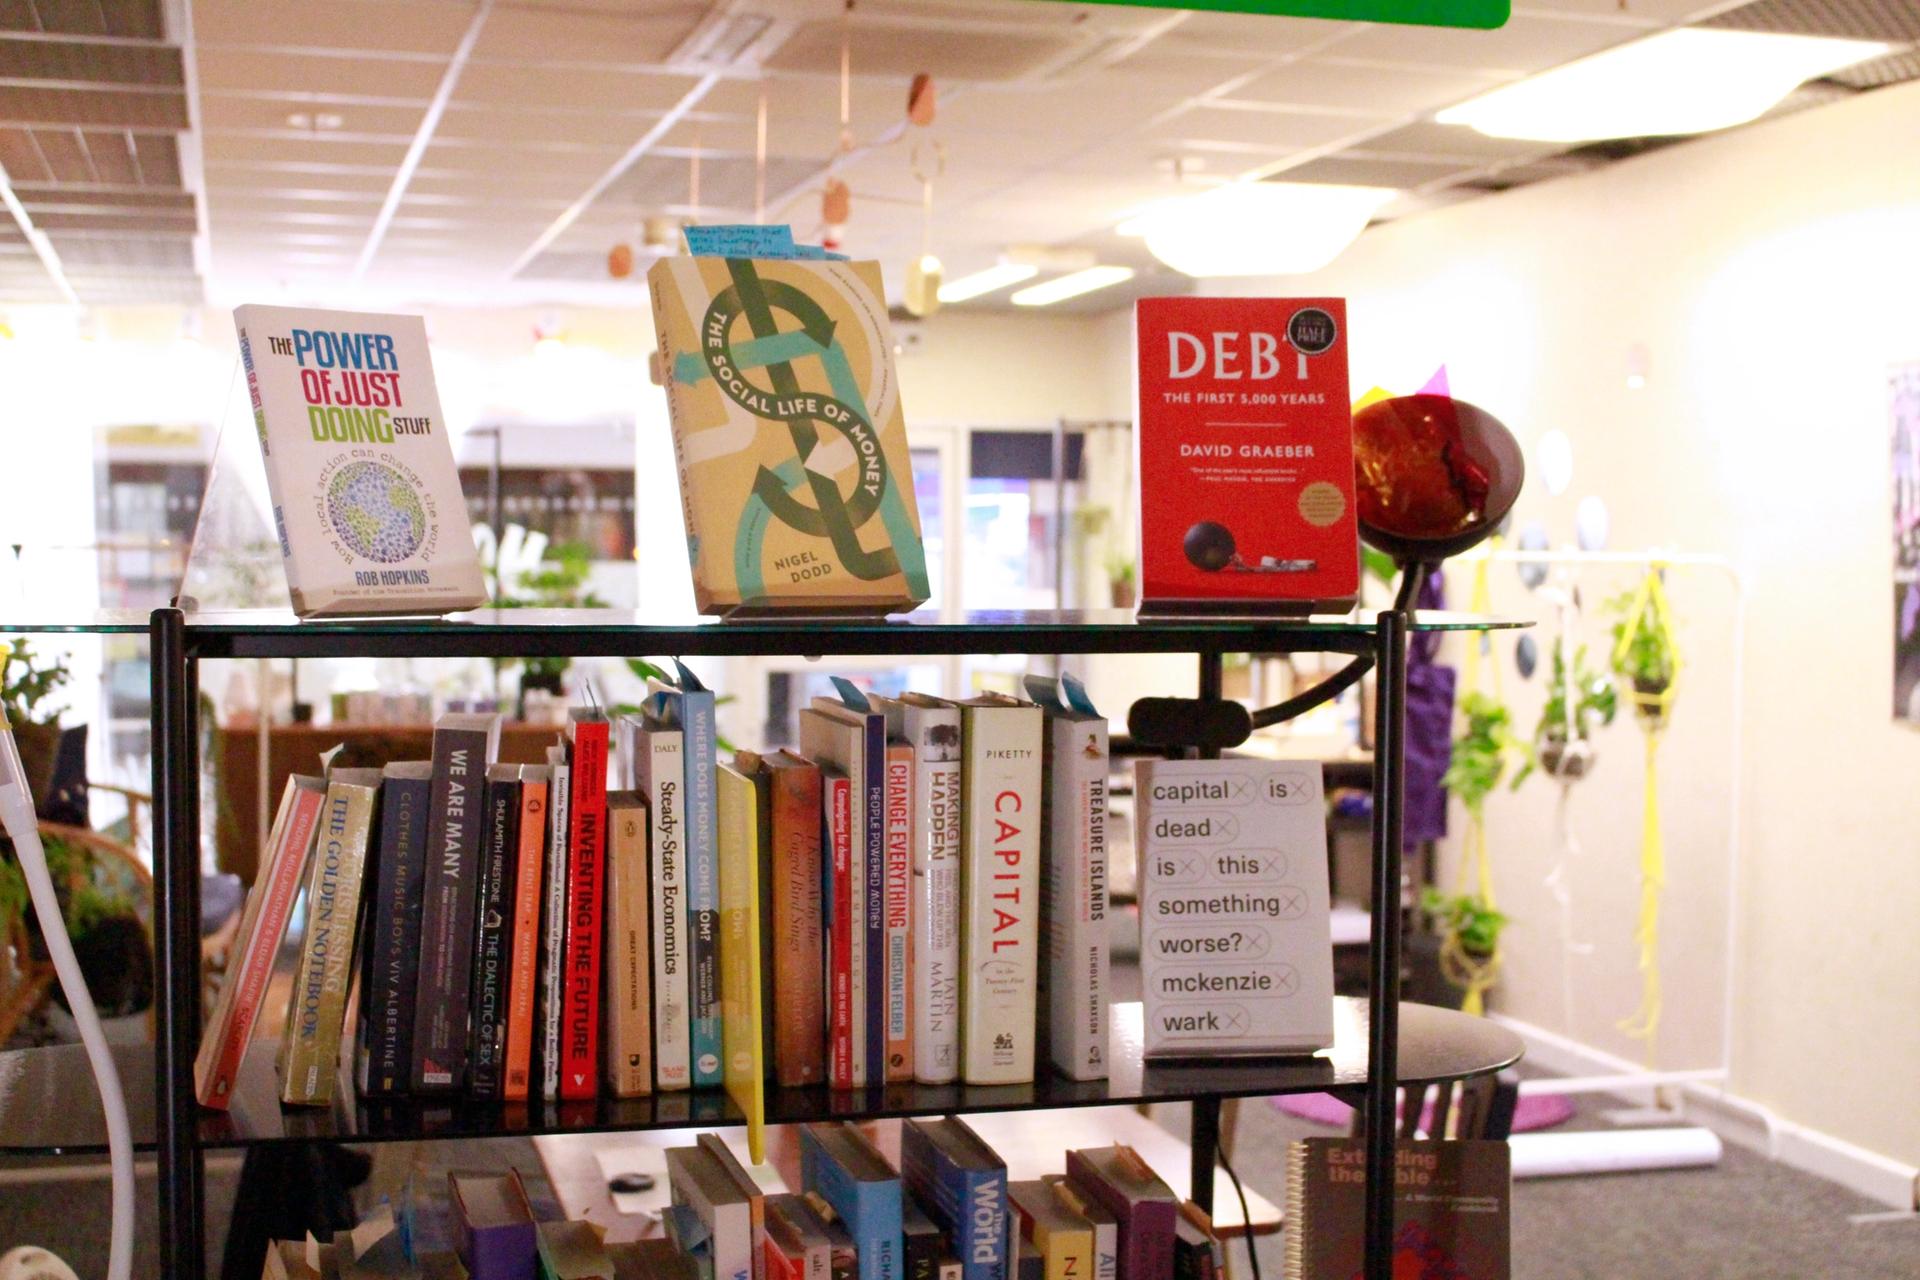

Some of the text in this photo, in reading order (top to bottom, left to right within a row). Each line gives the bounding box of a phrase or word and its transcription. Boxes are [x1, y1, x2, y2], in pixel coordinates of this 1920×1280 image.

[268, 329, 399, 371] THE POWER
[300, 369, 403, 407] OF JUST
[708, 311, 880, 497] THE SOCIAL LIFE OF MONEY
[1163, 392, 1191, 404] THE
[1197, 393, 1235, 404] FIRST
[1280, 393, 1326, 405] YEARS
[307, 406, 431, 443] DOING STUFF
[351, 449, 375, 458] can
[1180, 444, 1315, 458] DAVID GRAEBER
[355, 568, 431, 587] ROB HOPKINS
[774, 551, 818, 570] NIGEL
[790, 564, 832, 583] DODD
[654, 744, 678, 753] DALY
[695, 711, 707, 760] WHERE
[986, 750, 1032, 759] PIKETTY
[697, 763, 708, 798] DOES
[1153, 780, 1288, 804] capital is
[330, 795, 349, 836] THE
[442, 749, 468, 878] WE ARE MANY
[697, 802, 710, 852] MONEY
[869, 786, 881, 830] PEOPLE
[931, 771, 946, 861] HAPPEN
[946, 771, 960, 841] MAKING
[1155, 818, 1212, 838] dead
[490, 799, 507, 903] SHULAMITH FIRESTONE
[660, 781, 678, 882] Steady-State
[889, 764, 908, 928] CHANGE EVERYTHING
[946, 845, 960, 860] IT
[1090, 779, 1104, 921] TREASURE ISLANDS
[318, 841, 343, 921] GOLDEN
[575, 813, 598, 928] INVENTING
[698, 855, 711, 896] COME
[869, 832, 881, 886] POWERED
[992, 790, 1022, 954] CAPITAL
[1157, 856, 1260, 876] is this
[1158, 894, 1280, 917] something
[384, 792, 413, 1068] CLOTHES MUSIC BOYS VIV ALBERTINE
[574, 932, 594, 970] THE
[662, 885, 680, 976] Economics
[1159, 932, 1242, 953] worse?
[327, 915, 351, 994] LESSING
[301, 927, 331, 1040] NOTEBOOK
[480, 933, 499, 1065] THE DIALECTIC OF SEX
[890, 935, 904, 1034] CHRISTIAN FELBER
[931, 961, 943, 1033] MARTIN
[944, 977, 956, 1016] IAIN
[1089, 946, 1099, 1035] NICHOLAS SHAXSON
[1162, 972, 1272, 993] mckenzie
[572, 978, 592, 1058] FUTURE
[1163, 1012, 1219, 1032] wark
[974, 1180, 999, 1264] World
